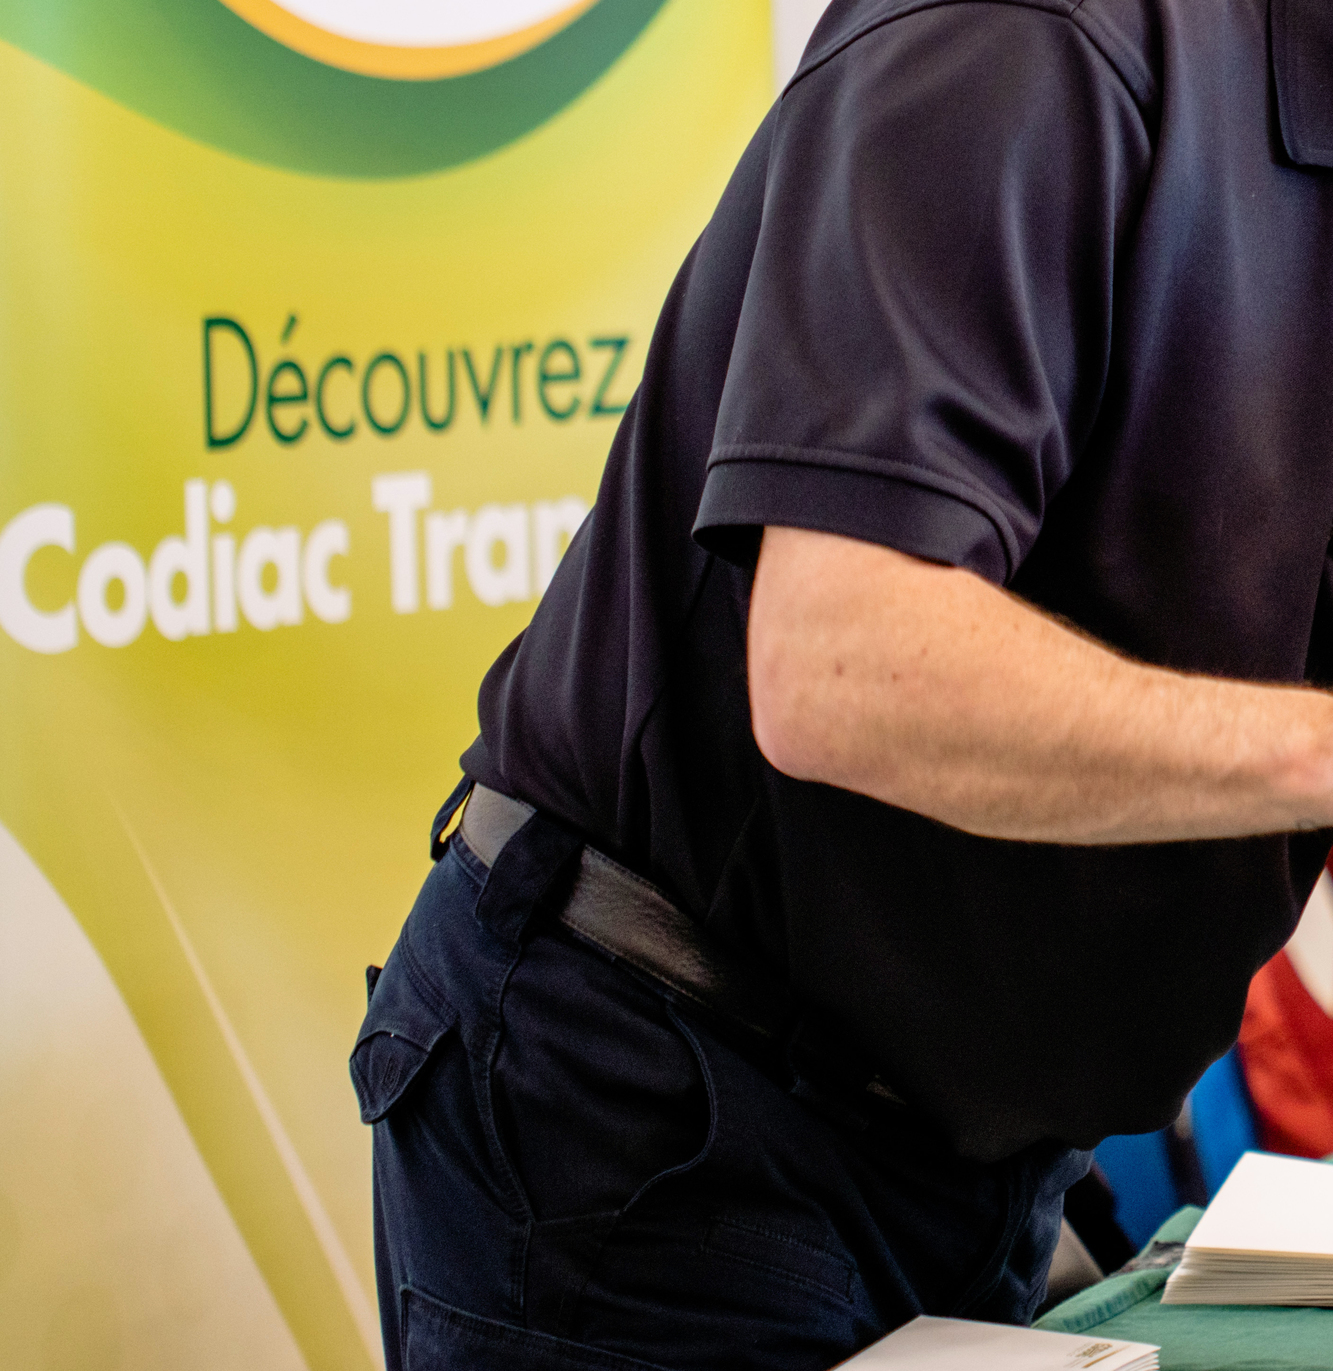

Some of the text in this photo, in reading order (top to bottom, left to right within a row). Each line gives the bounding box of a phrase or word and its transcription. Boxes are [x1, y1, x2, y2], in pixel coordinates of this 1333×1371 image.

[201, 314, 629, 451] Découvrez
[0, 470, 597, 654] Codiac Tran
